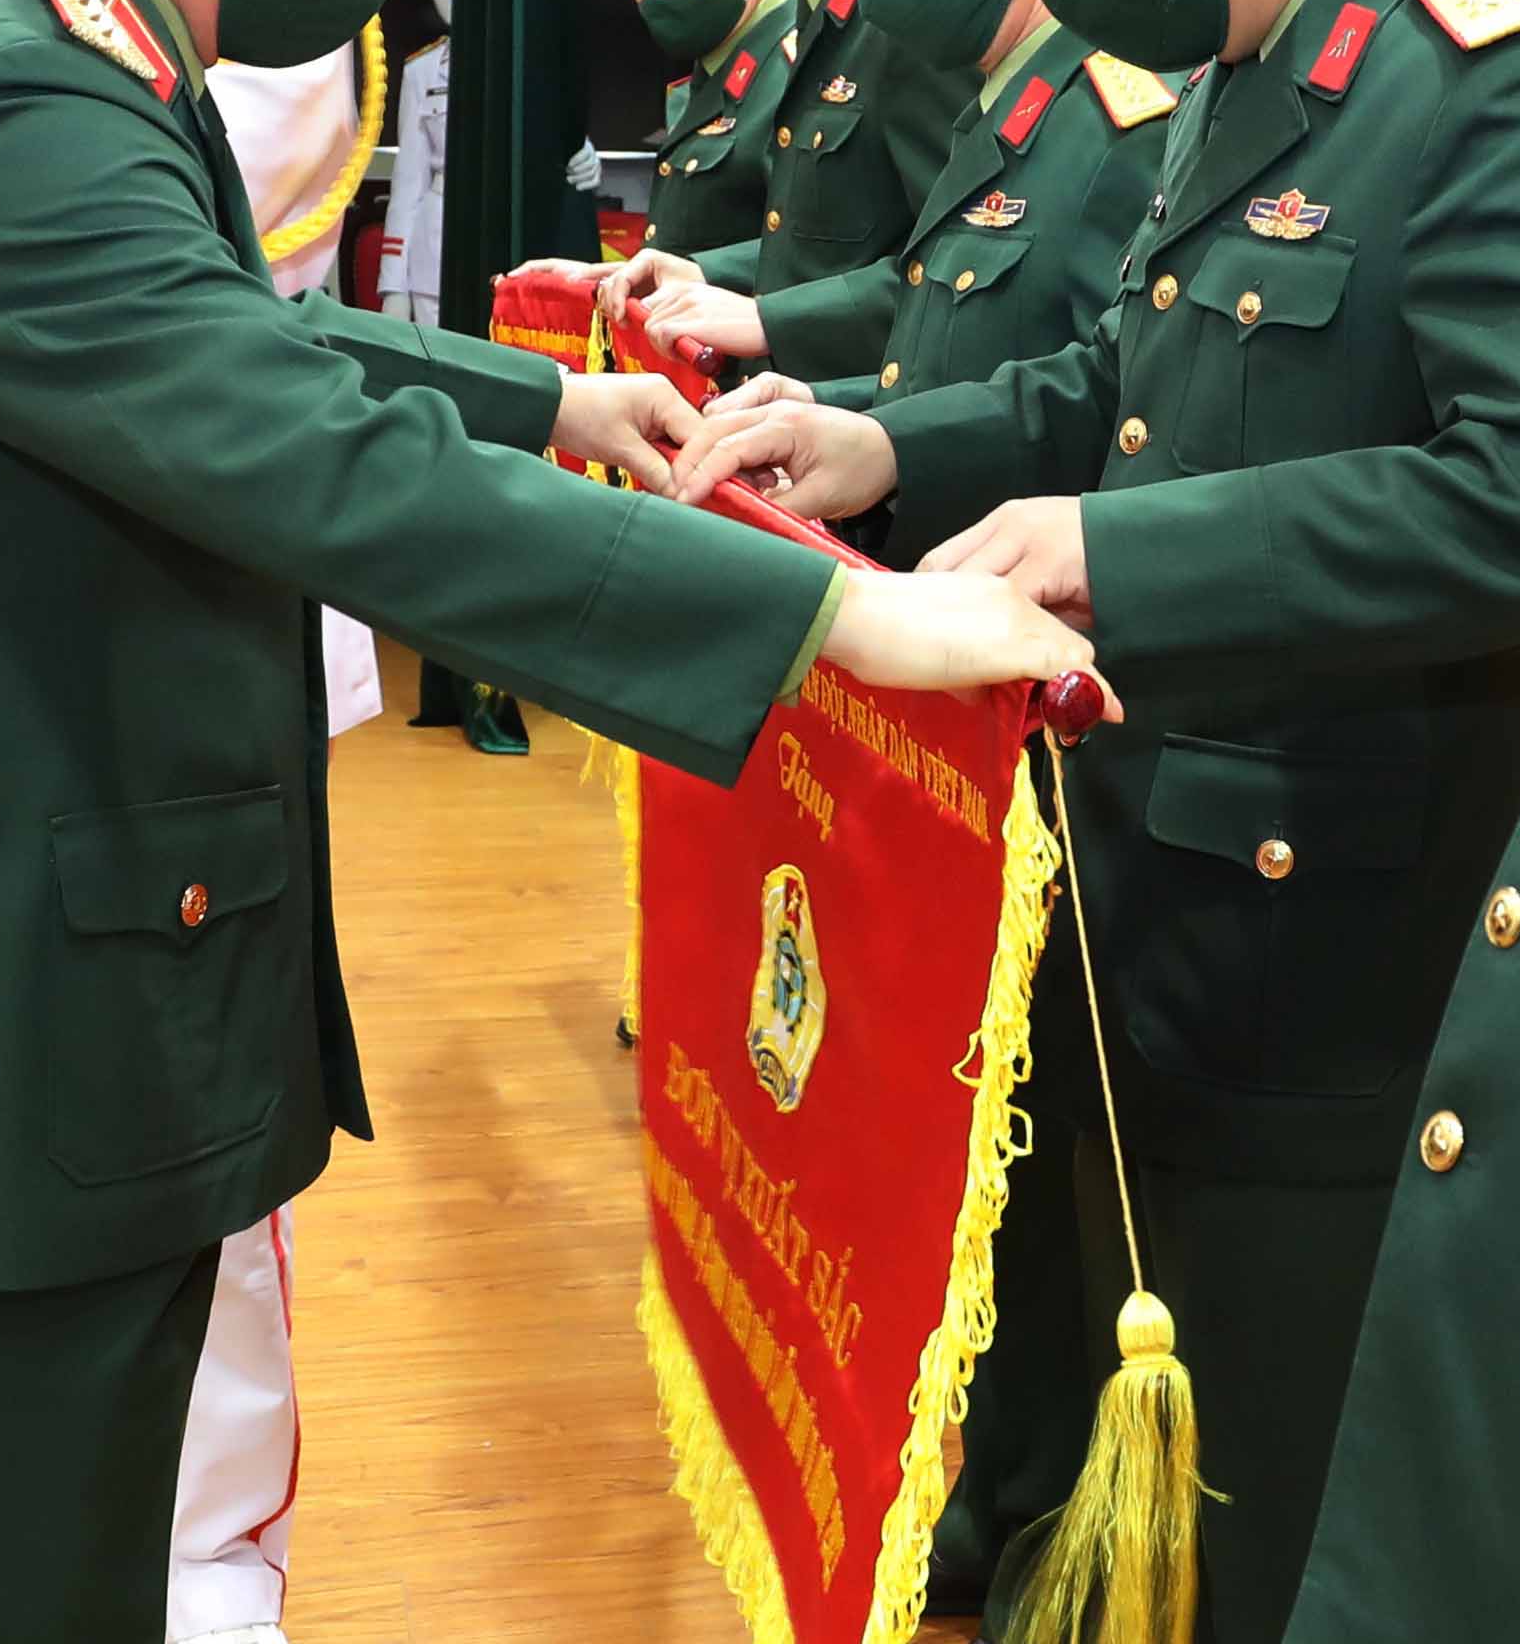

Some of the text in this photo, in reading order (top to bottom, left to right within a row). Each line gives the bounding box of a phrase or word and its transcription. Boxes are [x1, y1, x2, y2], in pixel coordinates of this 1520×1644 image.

[778, 731, 835, 842] Tặng
[845, 694, 888, 756] NHÂN
[889, 719, 918, 784] DÂN
[920, 747, 959, 816] VIỆT
[805, 1246, 863, 1369] SẮC
